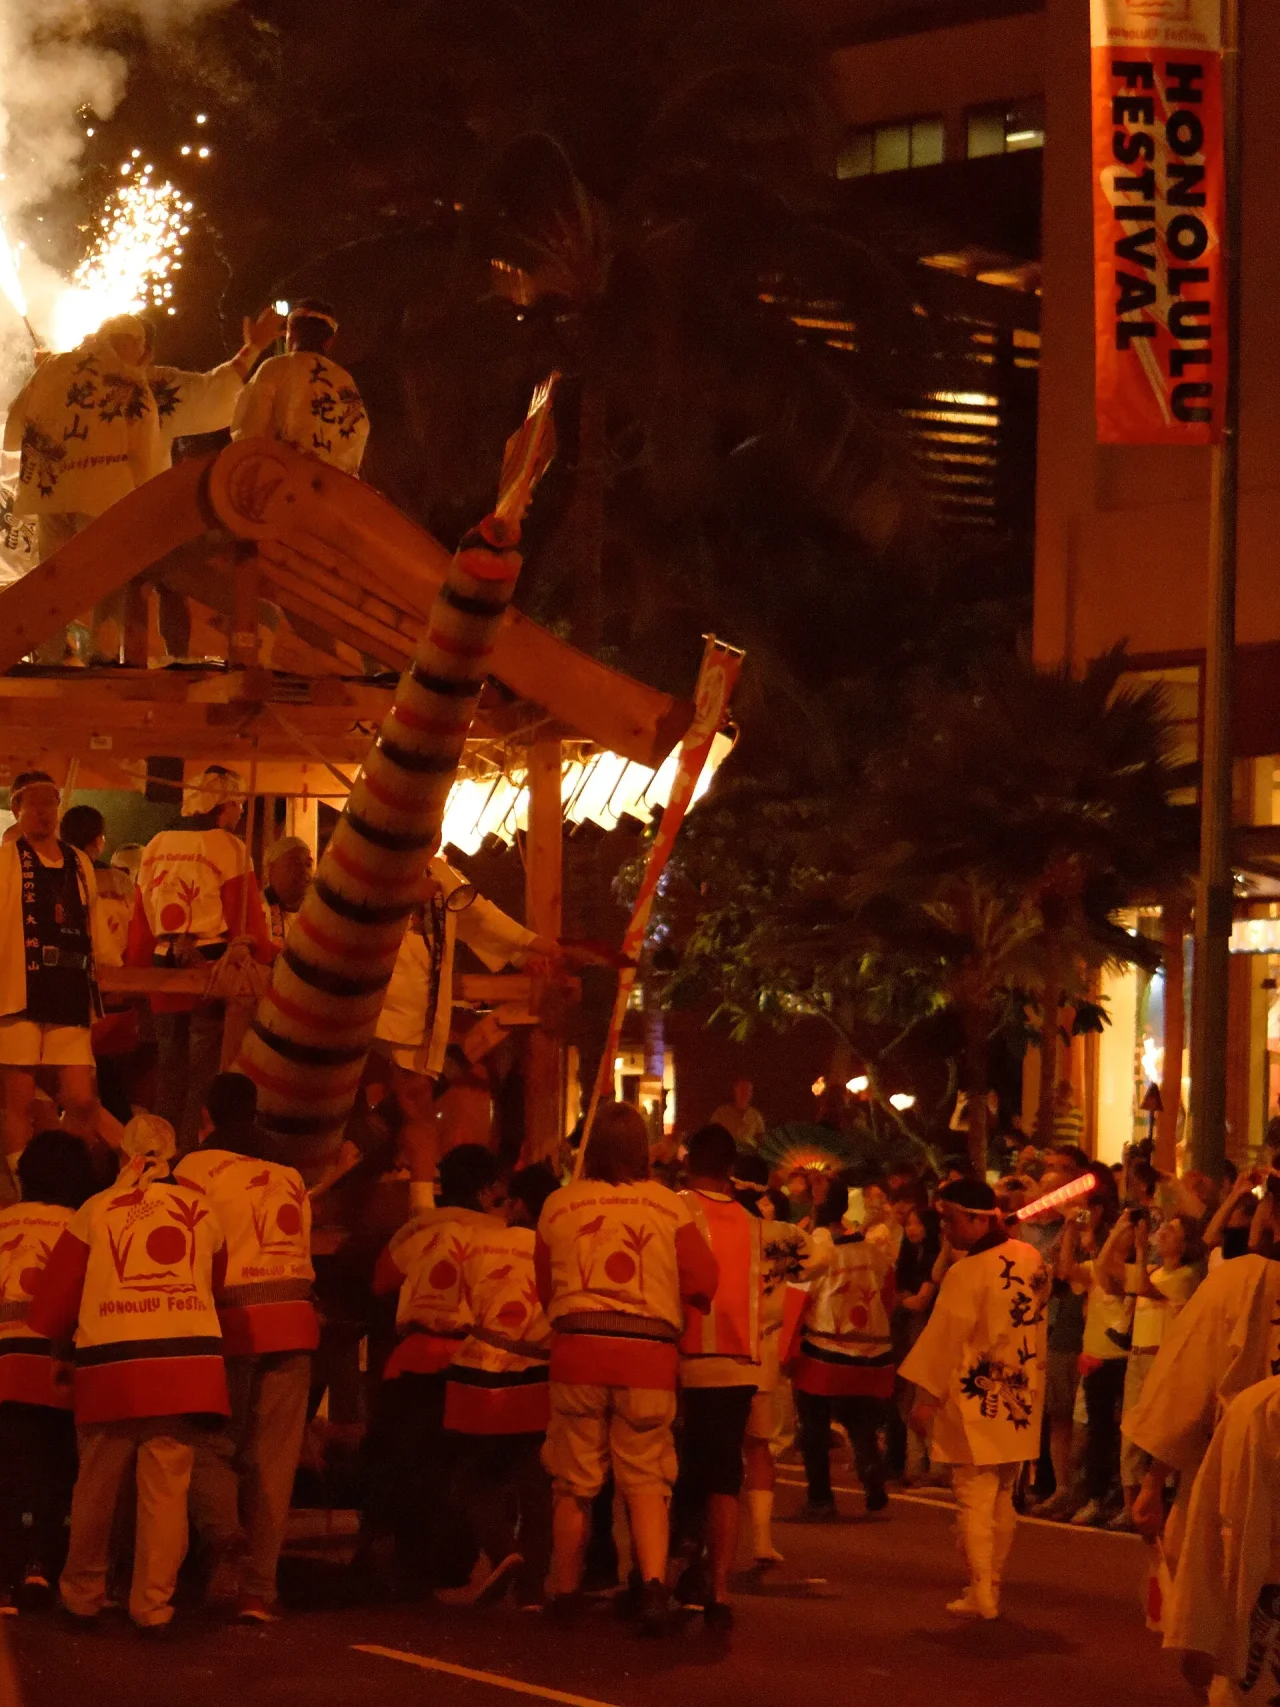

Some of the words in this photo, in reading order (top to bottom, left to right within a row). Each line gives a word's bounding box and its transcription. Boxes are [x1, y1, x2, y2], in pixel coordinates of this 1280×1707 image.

[1111, 60, 1158, 351] FESTIVAL
[1164, 61, 1214, 424] HONOLULU
[99, 1298, 161, 1317] HONOLULU
